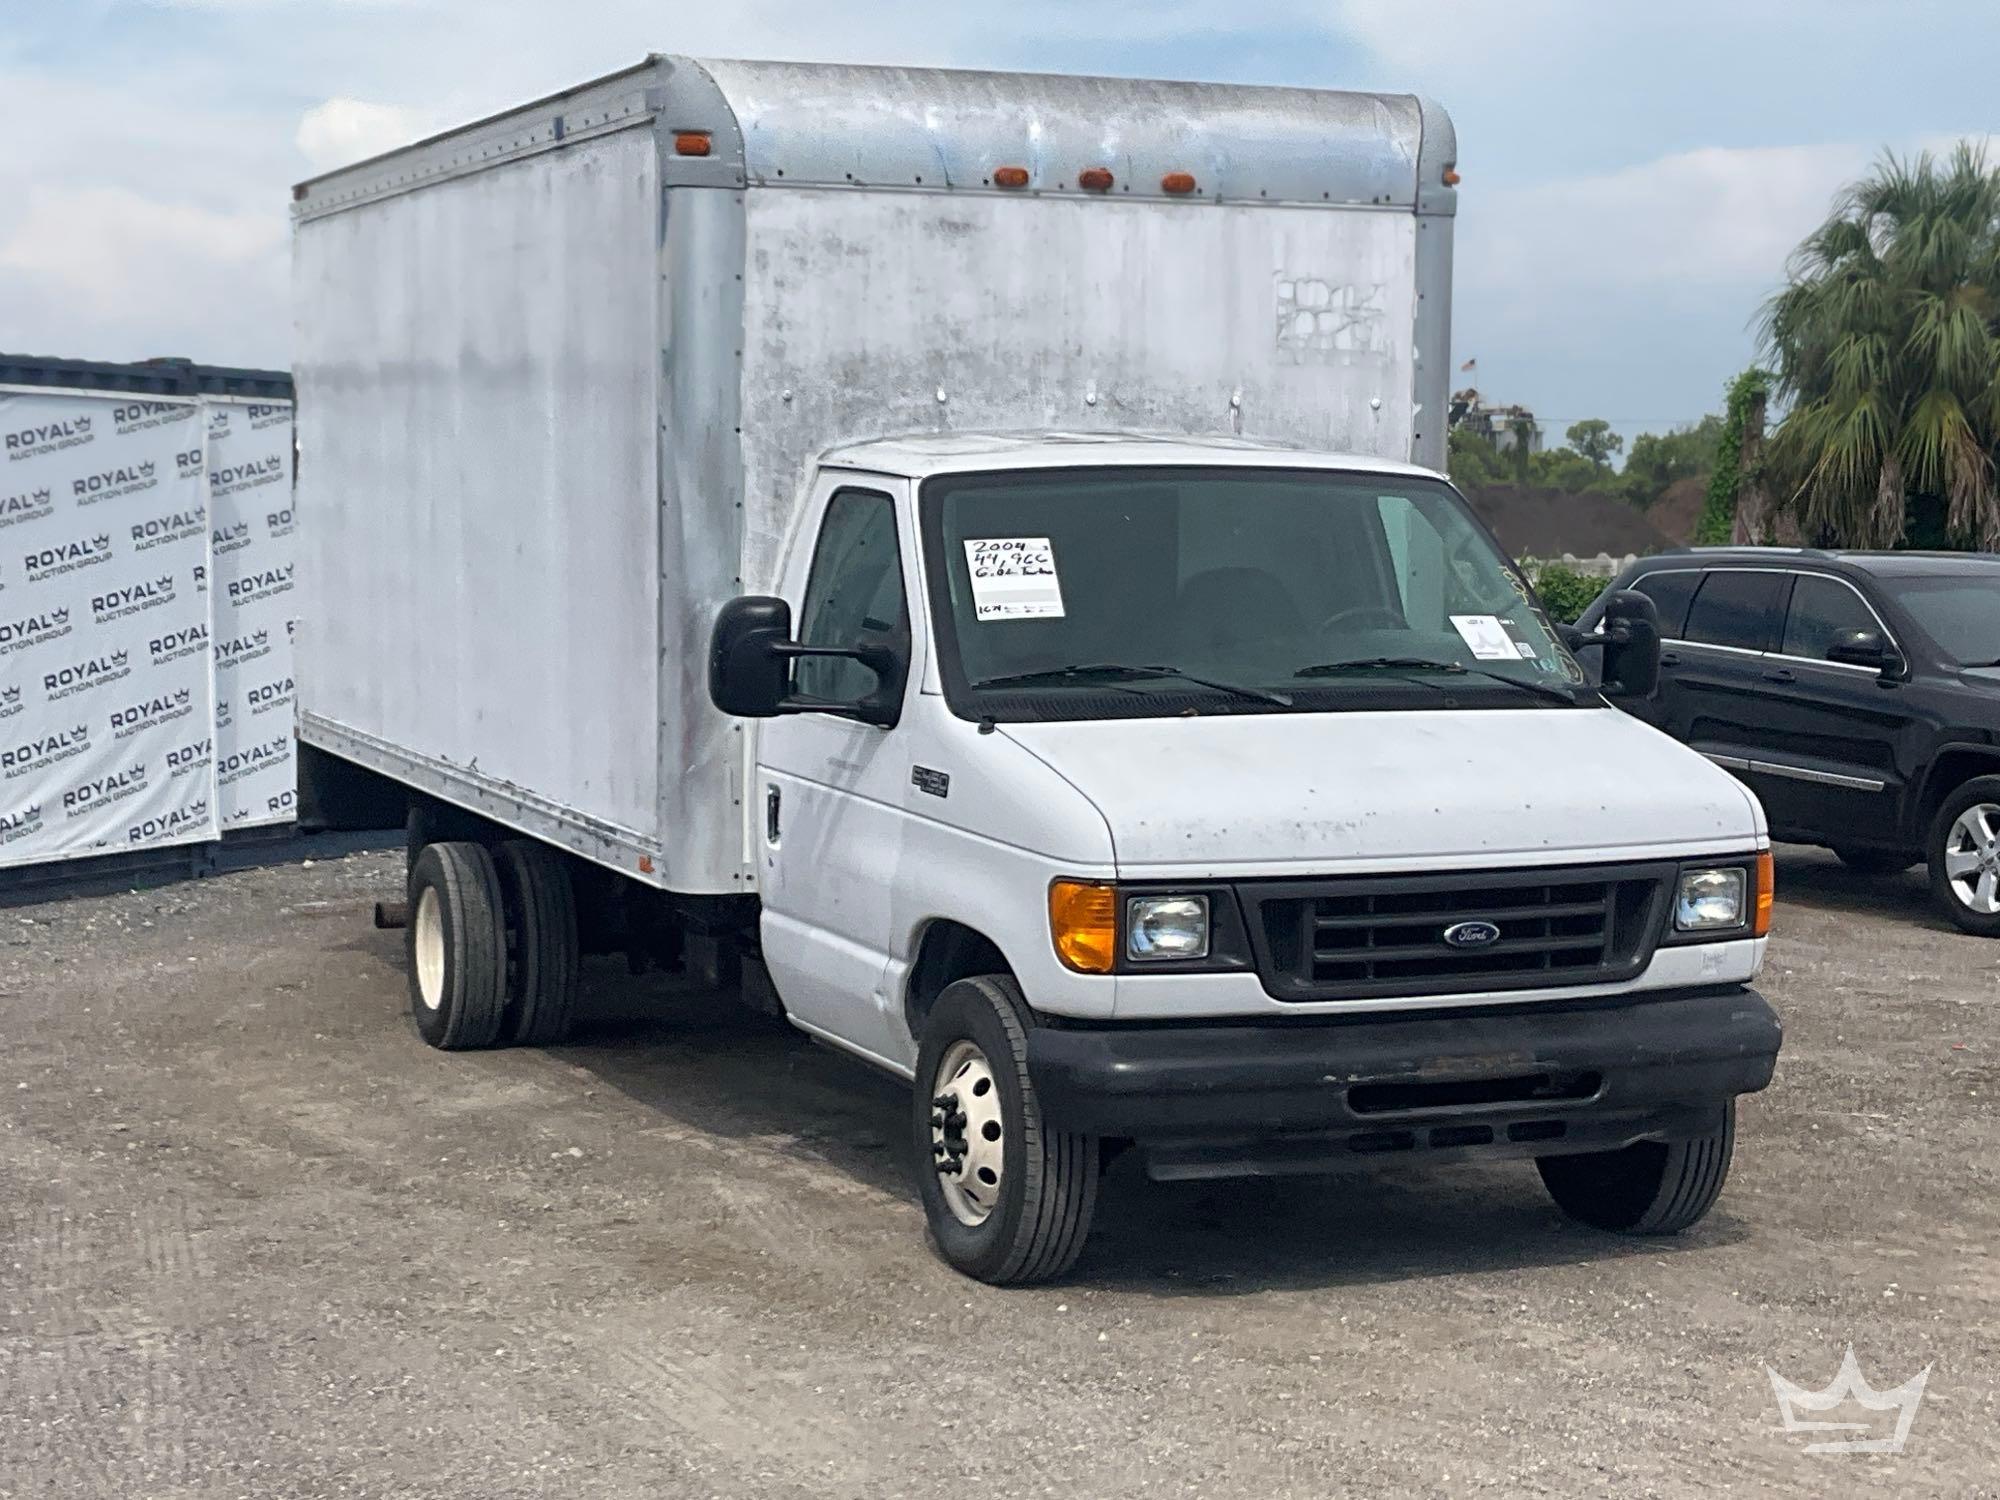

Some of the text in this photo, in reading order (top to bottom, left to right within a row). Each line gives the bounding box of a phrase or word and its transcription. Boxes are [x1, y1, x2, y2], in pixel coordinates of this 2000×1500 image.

[5, 421, 75, 449] ROYAL
[116, 419, 161, 435] AUCTION
[9, 433, 95, 462] AUCTION GROUP
[73, 466, 139, 496] ROYAL
[209, 461, 267, 487] ROYAL
[77, 478, 158, 507] AUCTION GROUP
[16, 505, 54, 523] GROUP
[131, 511, 195, 541] ROYAL
[24, 540, 93, 571] ROYAL
[135, 532, 179, 551] AUCTION
[220, 537, 251, 554] GROUP
[973, 541, 1026, 553] 2004
[29, 550, 113, 582] AUCTION GROUP
[228, 568, 287, 597] ROYAL
[91, 582, 158, 613] ROYAL
[95, 592, 176, 624] AUCTION GROUP
[232, 590, 272, 607] AUCTION
[35, 624, 73, 644] GROUP
[153, 645, 196, 666] AUCTION
[239, 645, 272, 662] GROUP
[44, 657, 112, 690] ROYAL
[48, 666, 132, 702] AUCTION GROUP
[110, 695, 175, 729] ROYAL
[114, 719, 158, 739] AUCTION
[158, 704, 194, 725] GROUP
[1, 732, 72, 769] ROYAL
[5, 742, 92, 779] AUCTION GROUP
[217, 743, 273, 774] ROYAL
[259, 751, 291, 771] GROUP
[63, 772, 130, 808] ROYAL
[67, 780, 149, 818] AUCTION GROUP
[5, 821, 44, 843] GROUP
[128, 807, 192, 842] ROYAL
[175, 815, 210, 836] GROUP
[1458, 927, 1488, 942] Ford
